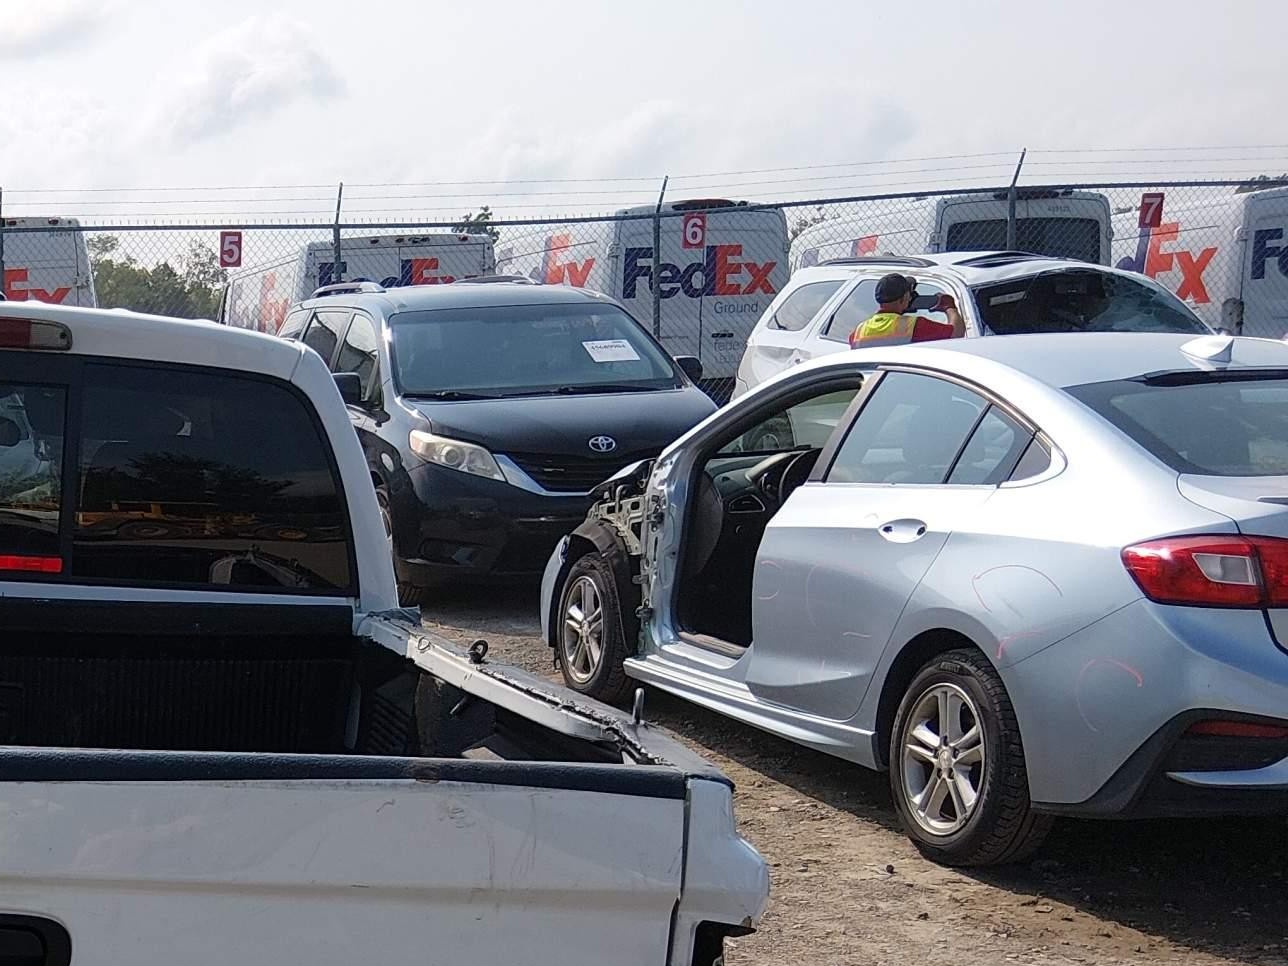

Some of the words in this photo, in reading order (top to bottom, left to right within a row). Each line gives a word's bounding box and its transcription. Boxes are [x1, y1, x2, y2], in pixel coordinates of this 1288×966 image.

[1143, 197, 1162, 224] 7
[685, 217, 704, 245] 6
[222, 235, 240, 264] 5
[496, 233, 596, 289] FdEx
[1251, 227, 1288, 280] F
[622, 244, 777, 299] FedEx
[713, 301, 759, 314] Ground
